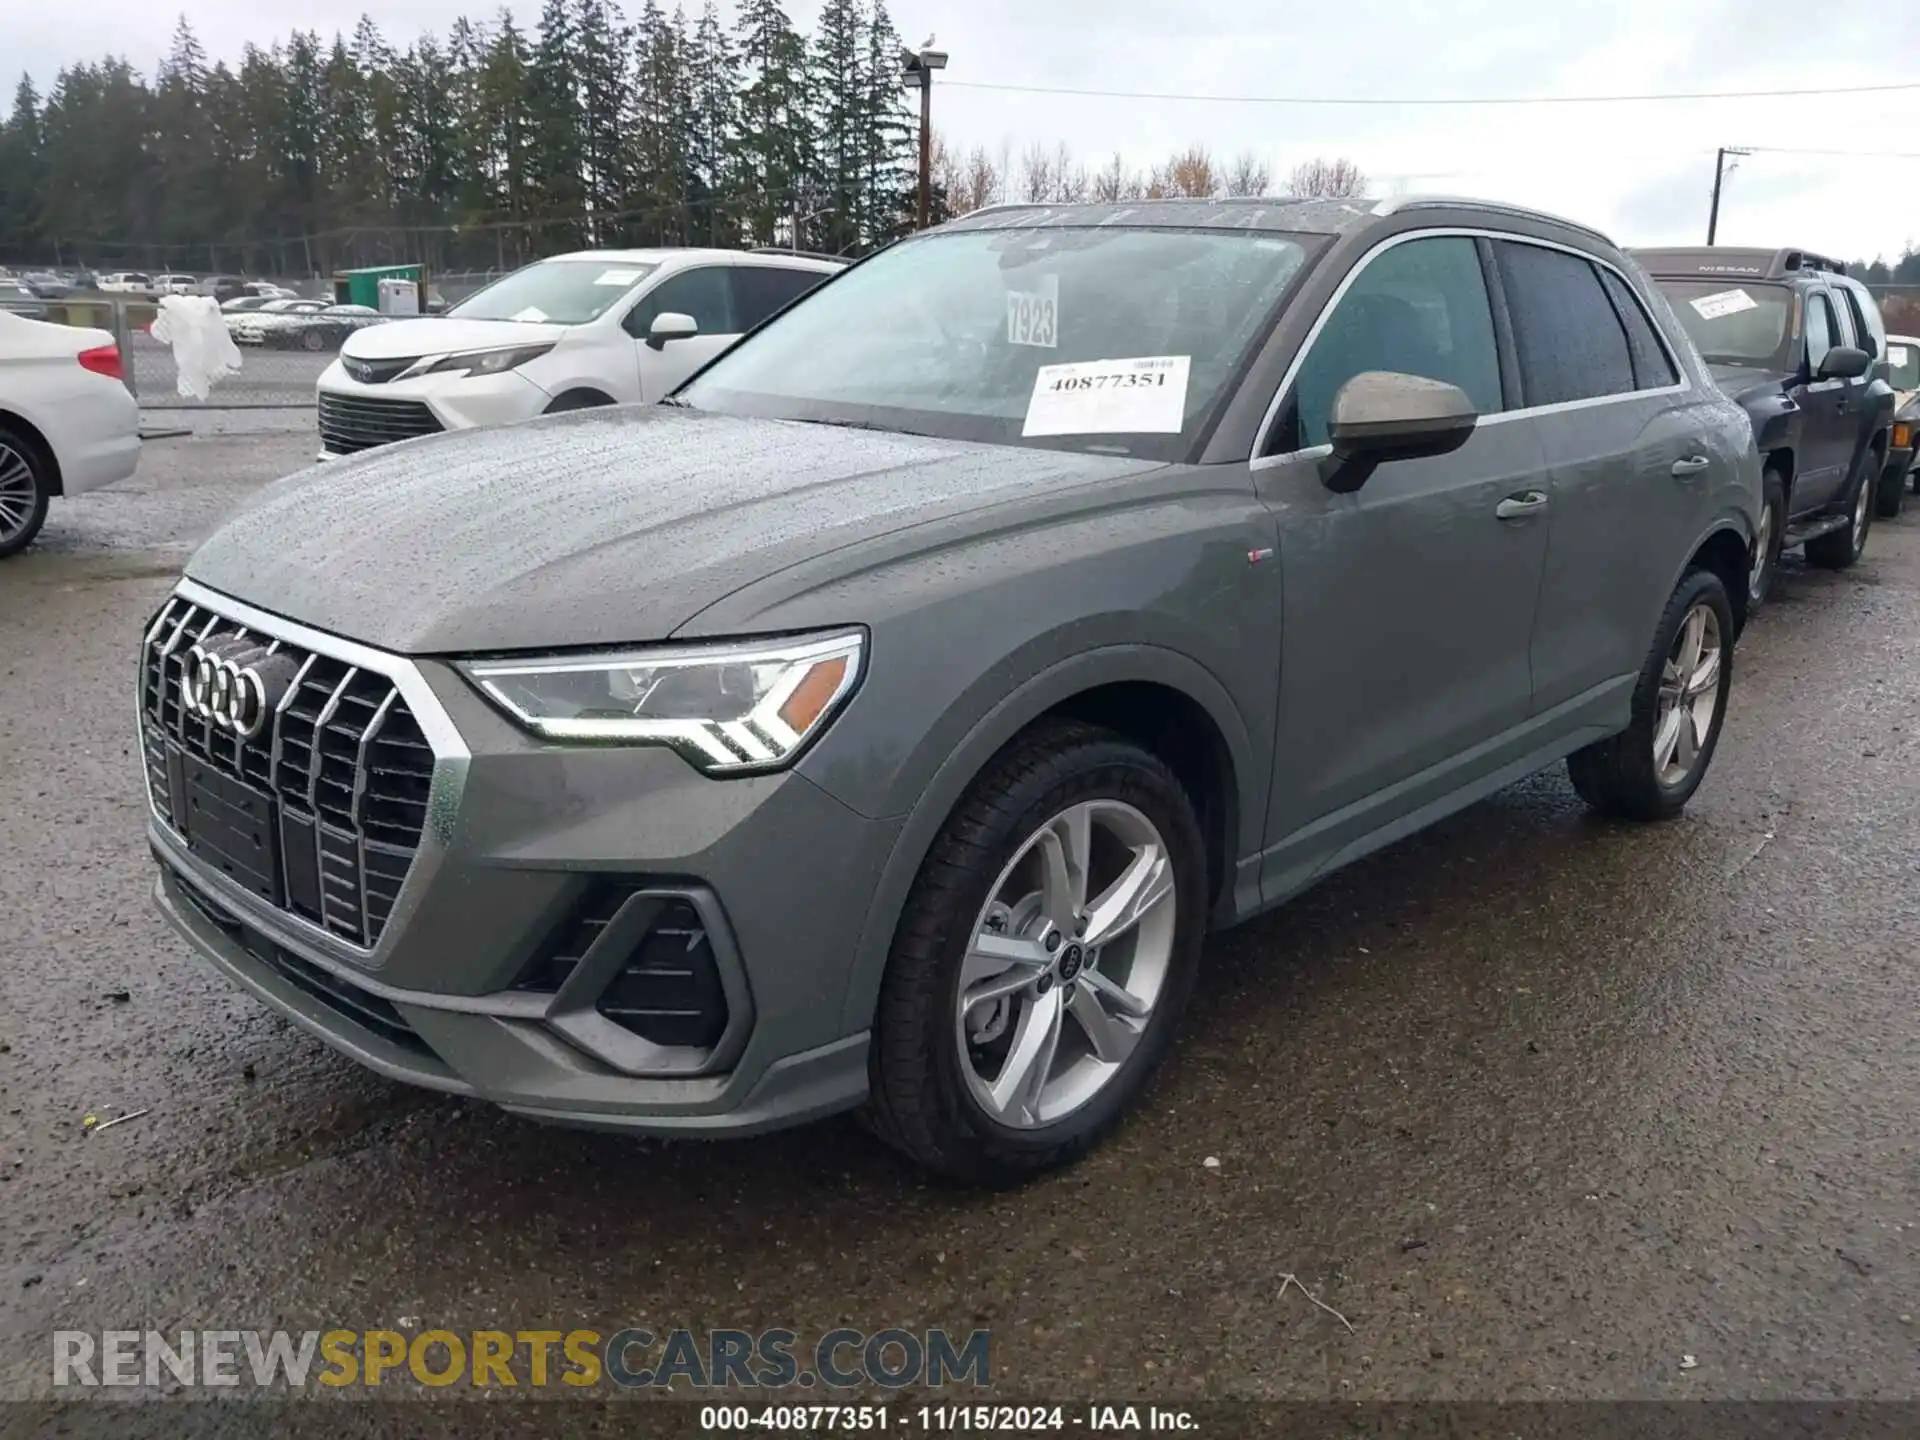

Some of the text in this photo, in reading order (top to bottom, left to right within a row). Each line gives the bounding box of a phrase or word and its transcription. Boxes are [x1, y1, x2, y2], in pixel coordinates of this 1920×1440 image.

[1698, 265, 1761, 273] NISSAN
[1010, 297, 1055, 345] 7923
[1049, 372, 1167, 392] 40877351
